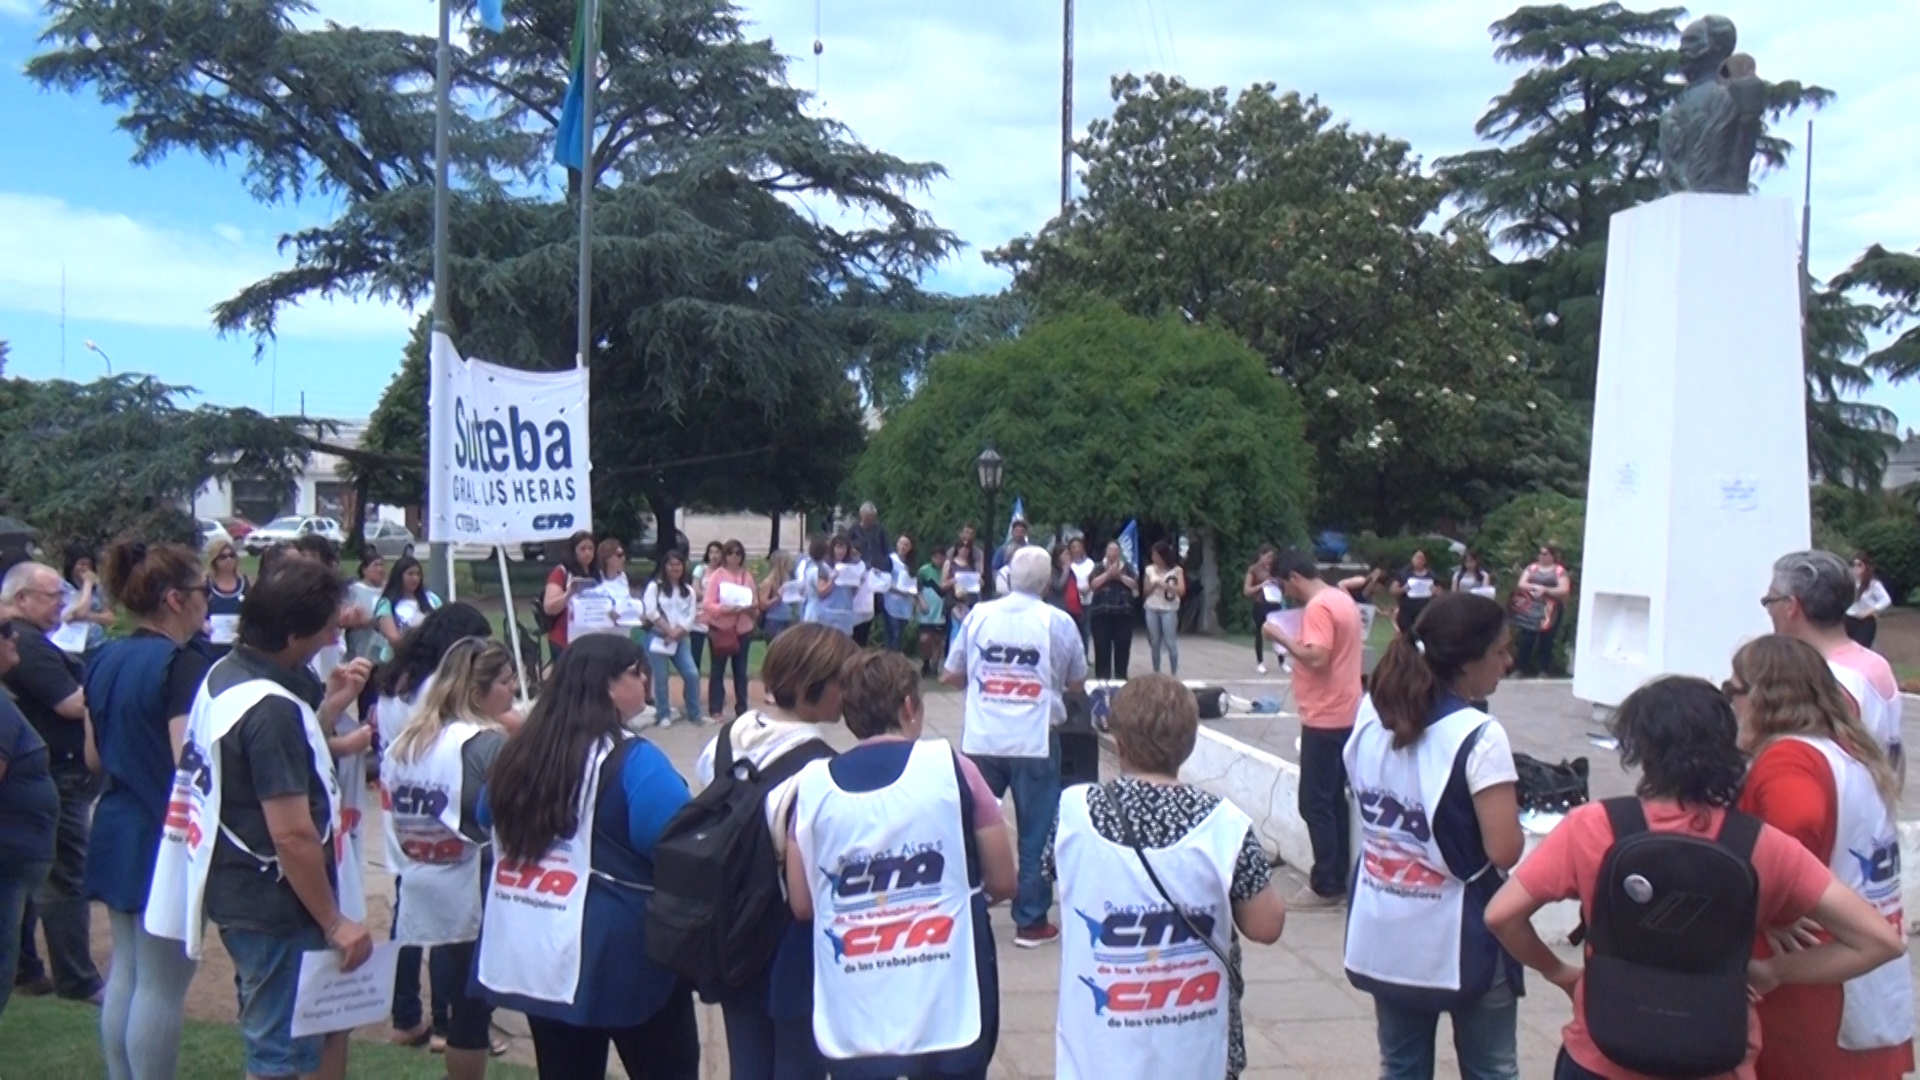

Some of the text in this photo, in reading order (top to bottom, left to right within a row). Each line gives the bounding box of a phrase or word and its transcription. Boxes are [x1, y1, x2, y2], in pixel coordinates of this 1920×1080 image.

[455, 396, 573, 473] Suteba
[512, 476, 576, 504] HERAS
[532, 512, 575, 531] CTA
[984, 645, 1040, 667] CTA
[983, 679, 1042, 698] CTA
[393, 785, 449, 819] CTA
[1357, 791, 1431, 843] CTA
[496, 857, 578, 898] CTA
[838, 849, 945, 898] CTA
[1363, 848, 1446, 888] CTA
[842, 915, 954, 958] CTA
[1099, 912, 1216, 948] CTA
[843, 951, 952, 974] de los trabajadores
[1105, 971, 1221, 1012] CTA
[1107, 1007, 1219, 1029] de los trabajadores
